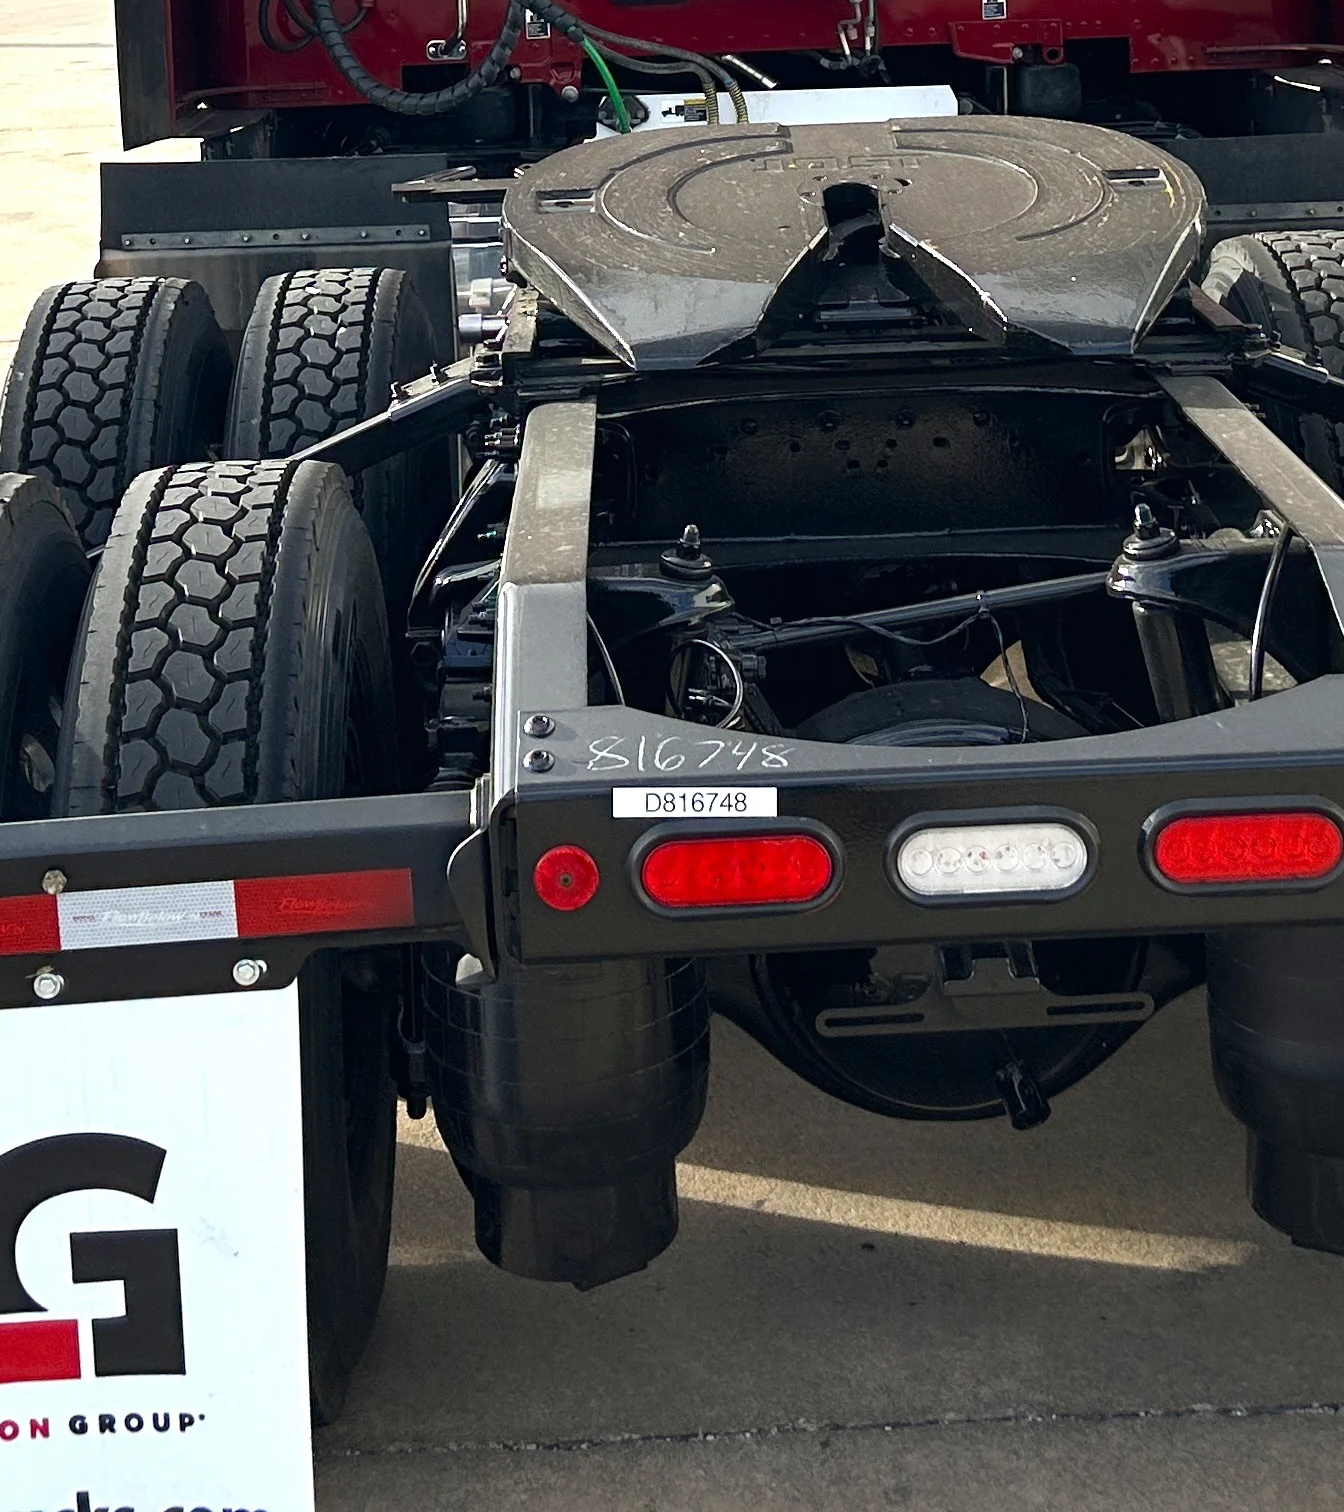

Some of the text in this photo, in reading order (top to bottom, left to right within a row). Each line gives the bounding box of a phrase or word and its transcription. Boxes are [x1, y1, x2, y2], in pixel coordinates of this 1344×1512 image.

[587, 735, 796, 771] 816748
[645, 793, 747, 813] D816748
[69, 1412, 196, 1435] GROUP
